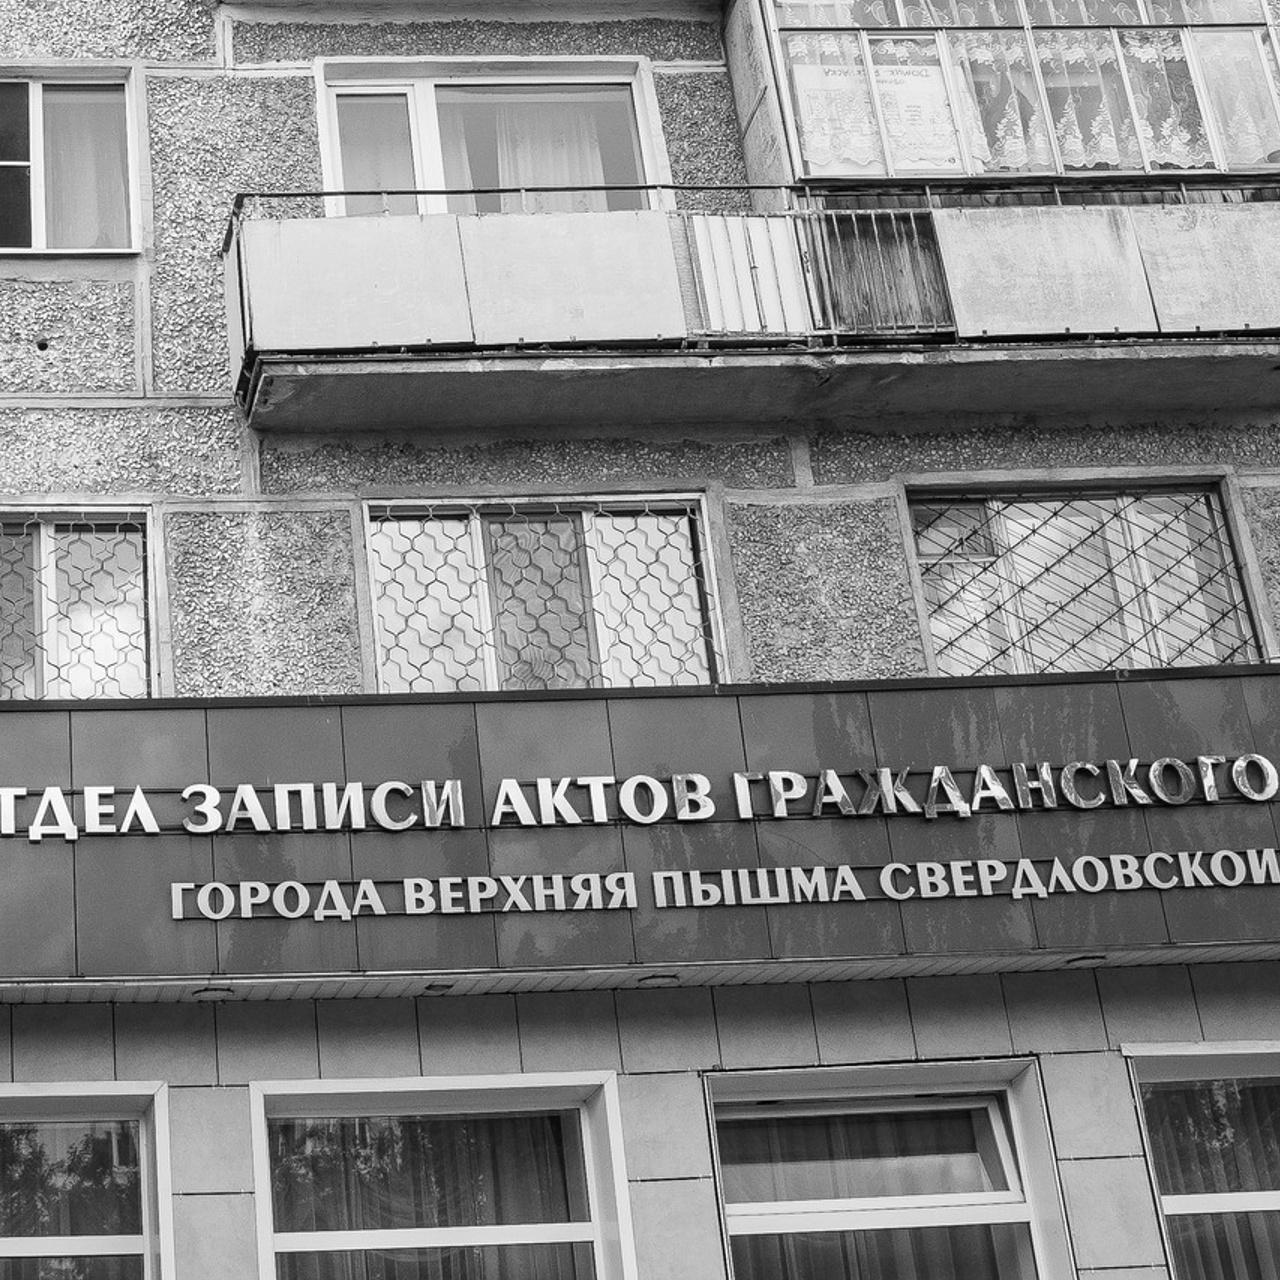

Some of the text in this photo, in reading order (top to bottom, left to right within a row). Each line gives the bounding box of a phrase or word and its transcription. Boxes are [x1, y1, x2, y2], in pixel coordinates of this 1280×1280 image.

[180, 780, 465, 833] ЗАПИСИ
[491, 773, 716, 825] АКТОВ
[733, 753, 1280, 819] ГРАЖДАНСКОГО
[170, 879, 387, 921] ГОРОДА
[403, 872, 638, 915] ВЕРХНЯЯ
[652, 864, 867, 908] ПЫШМА
